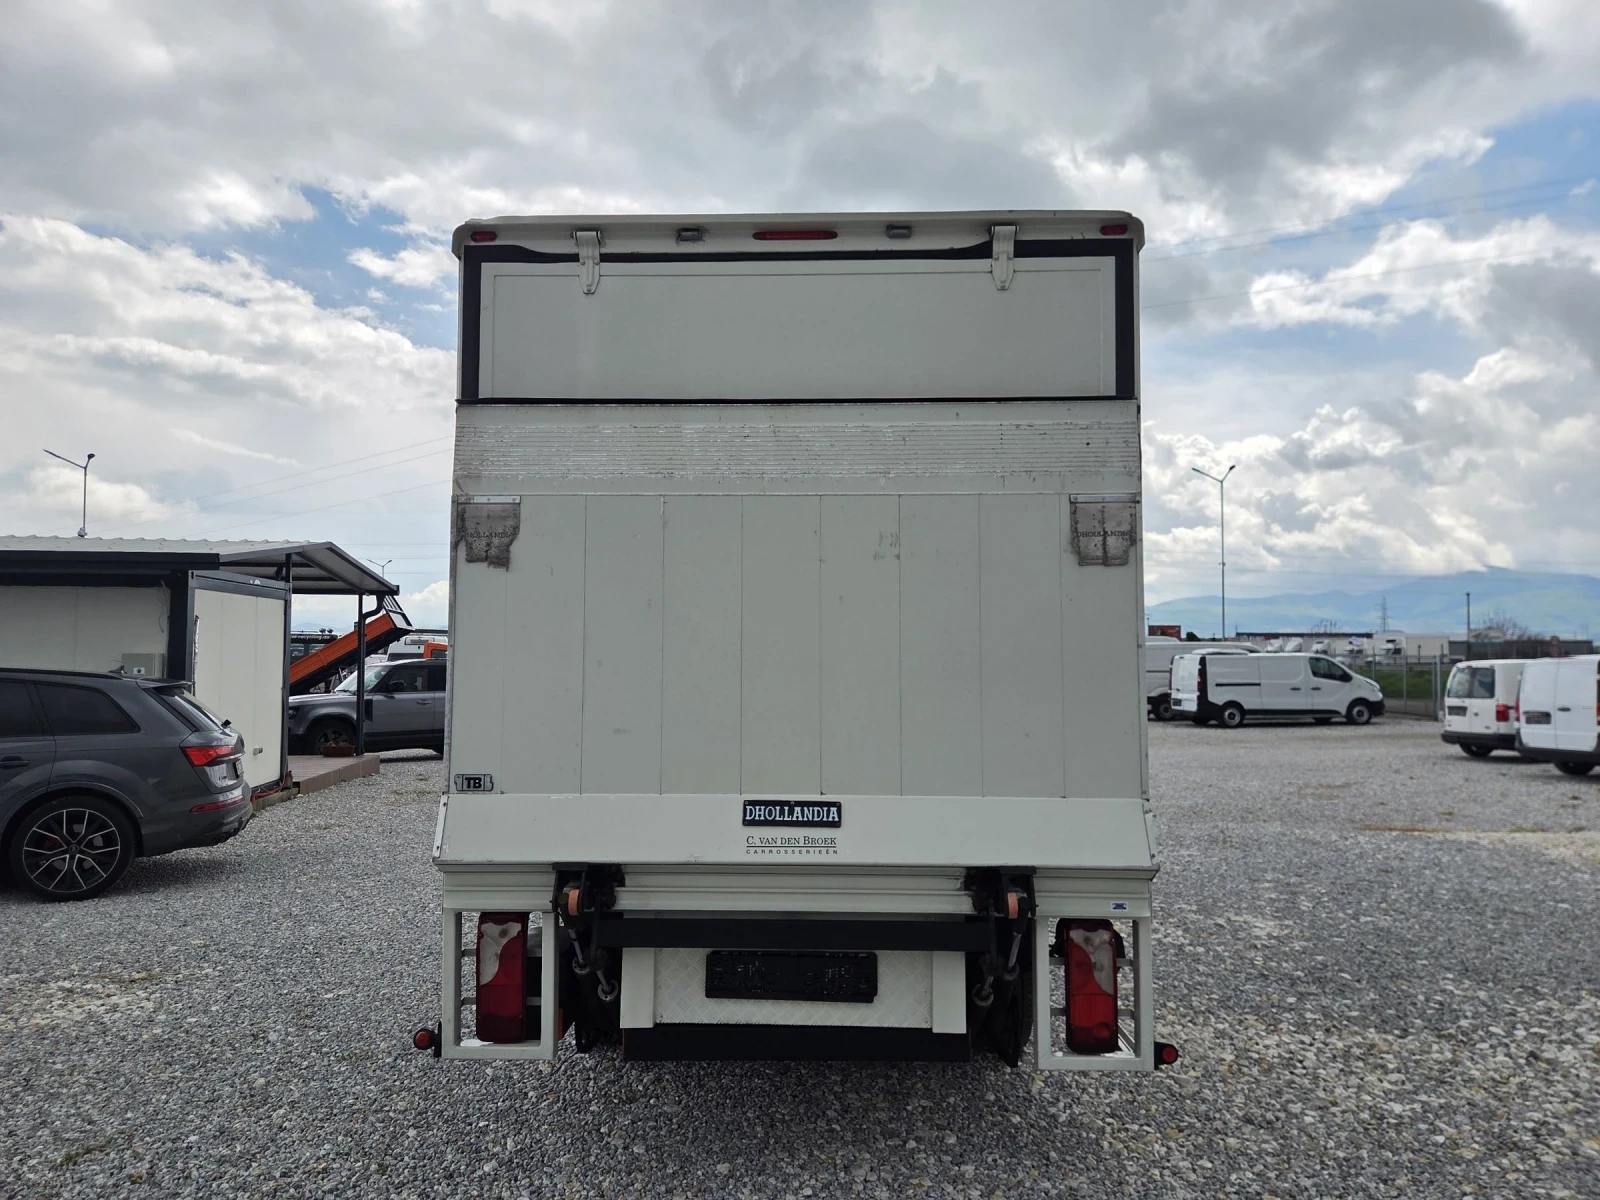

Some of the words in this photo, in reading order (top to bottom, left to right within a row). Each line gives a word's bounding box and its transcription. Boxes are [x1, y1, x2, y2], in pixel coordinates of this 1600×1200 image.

[465, 776, 482, 788] TB
[745, 805, 839, 821] DHOLLANDIA
[746, 835, 757, 845] C.
[759, 837, 778, 845] VAN
[780, 837, 801, 845] DEN
[803, 835, 837, 845] BROEK
